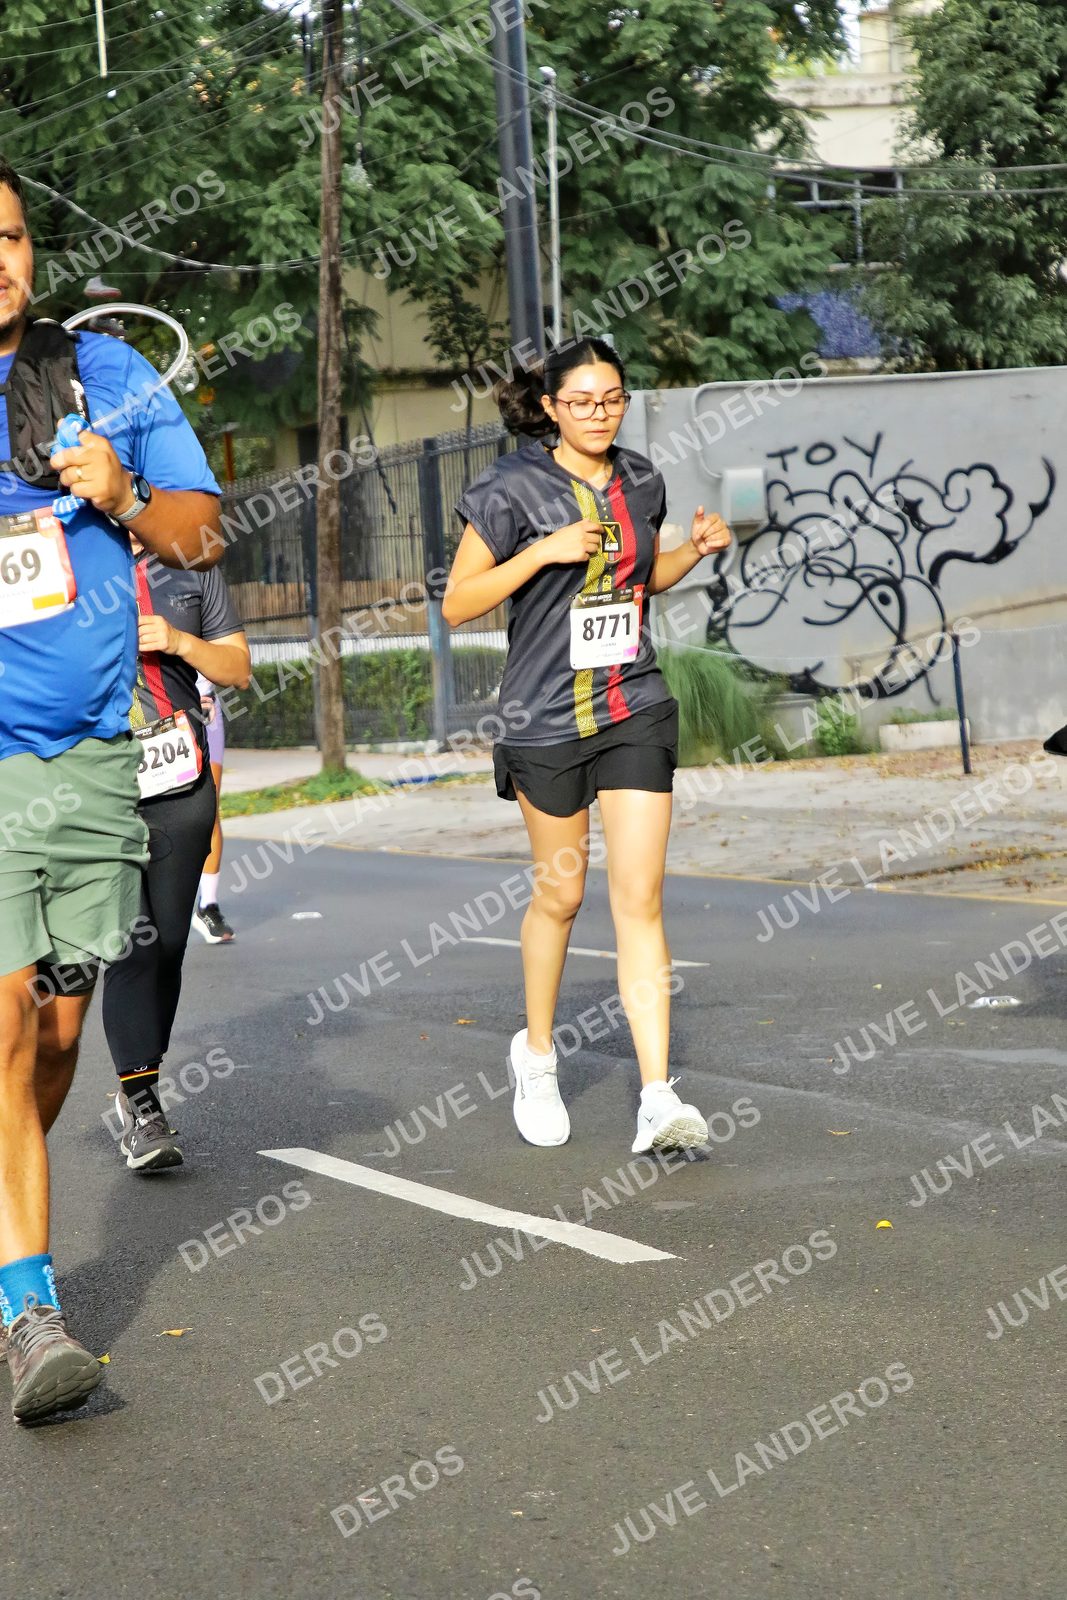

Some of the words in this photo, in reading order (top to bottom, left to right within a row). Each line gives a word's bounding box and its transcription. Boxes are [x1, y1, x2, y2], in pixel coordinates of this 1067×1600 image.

[766, 431, 883, 477] TOY
[0, 548, 41, 585] 69
[582, 612, 631, 641] 8771
